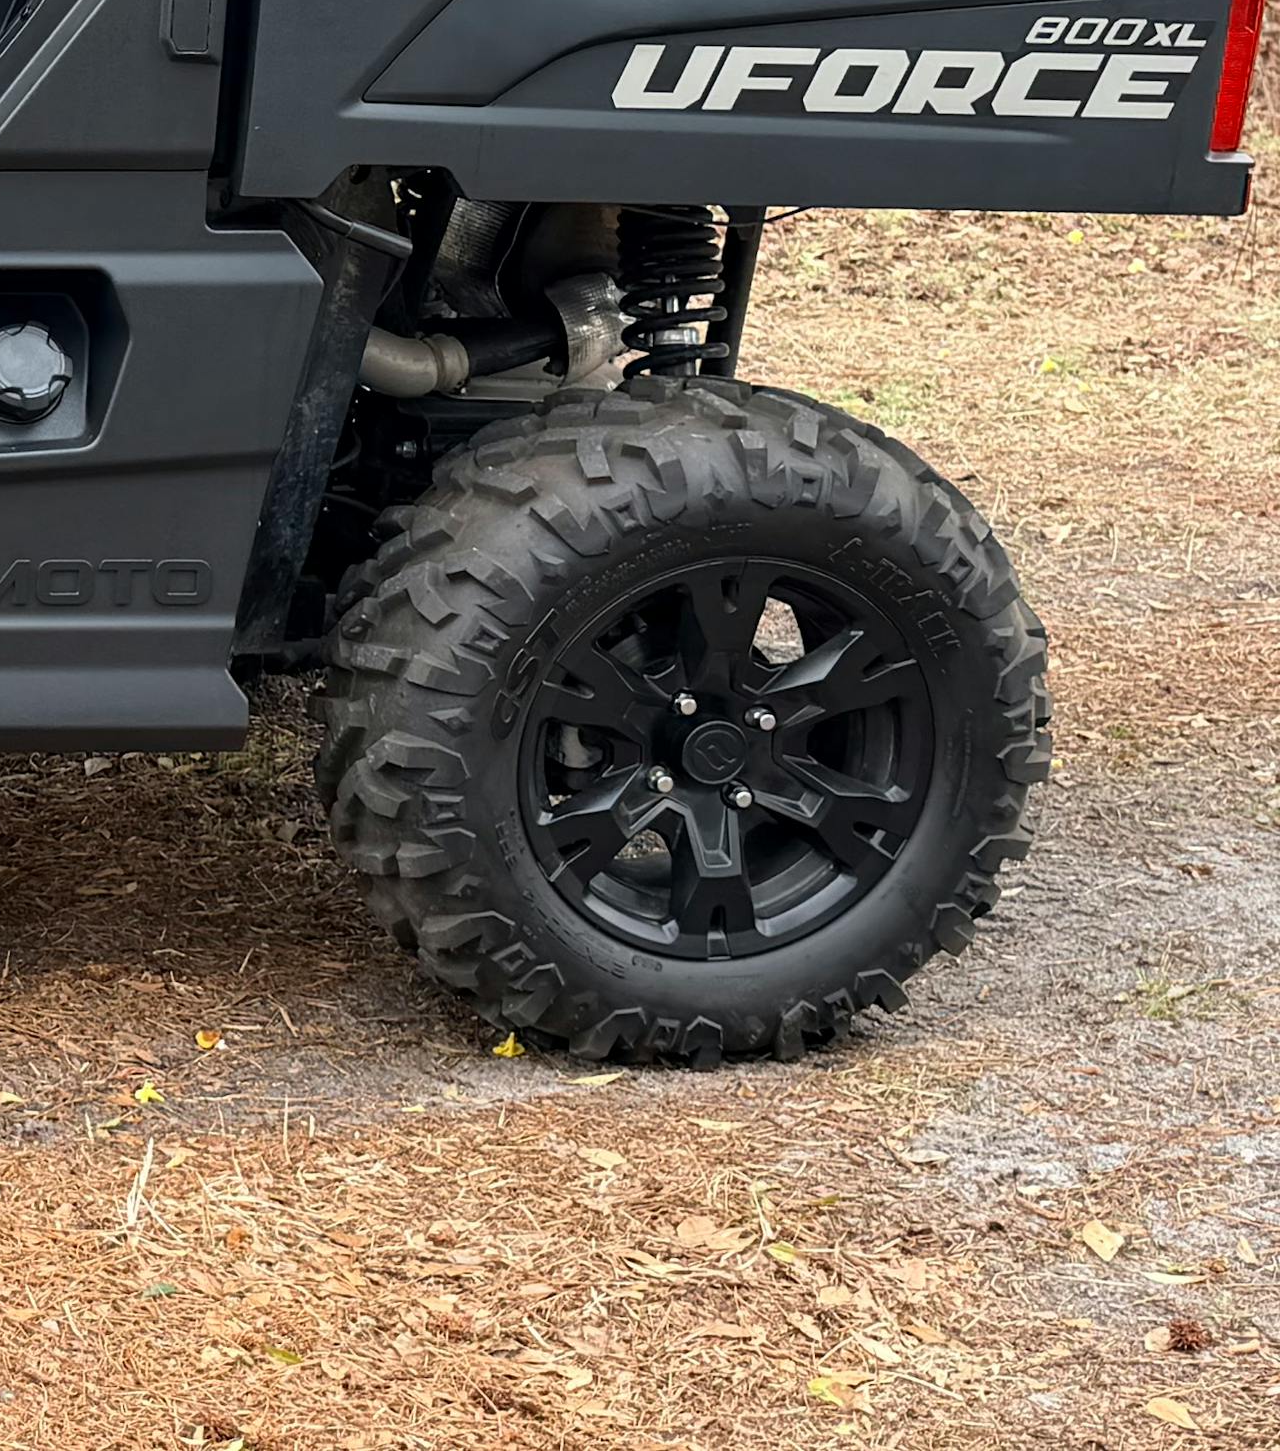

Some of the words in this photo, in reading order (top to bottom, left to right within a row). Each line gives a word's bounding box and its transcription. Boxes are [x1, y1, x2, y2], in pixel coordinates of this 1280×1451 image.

[1025, 17, 1148, 46] 800
[1144, 23, 1207, 47] XL
[611, 44, 1199, 119] UFORCE
